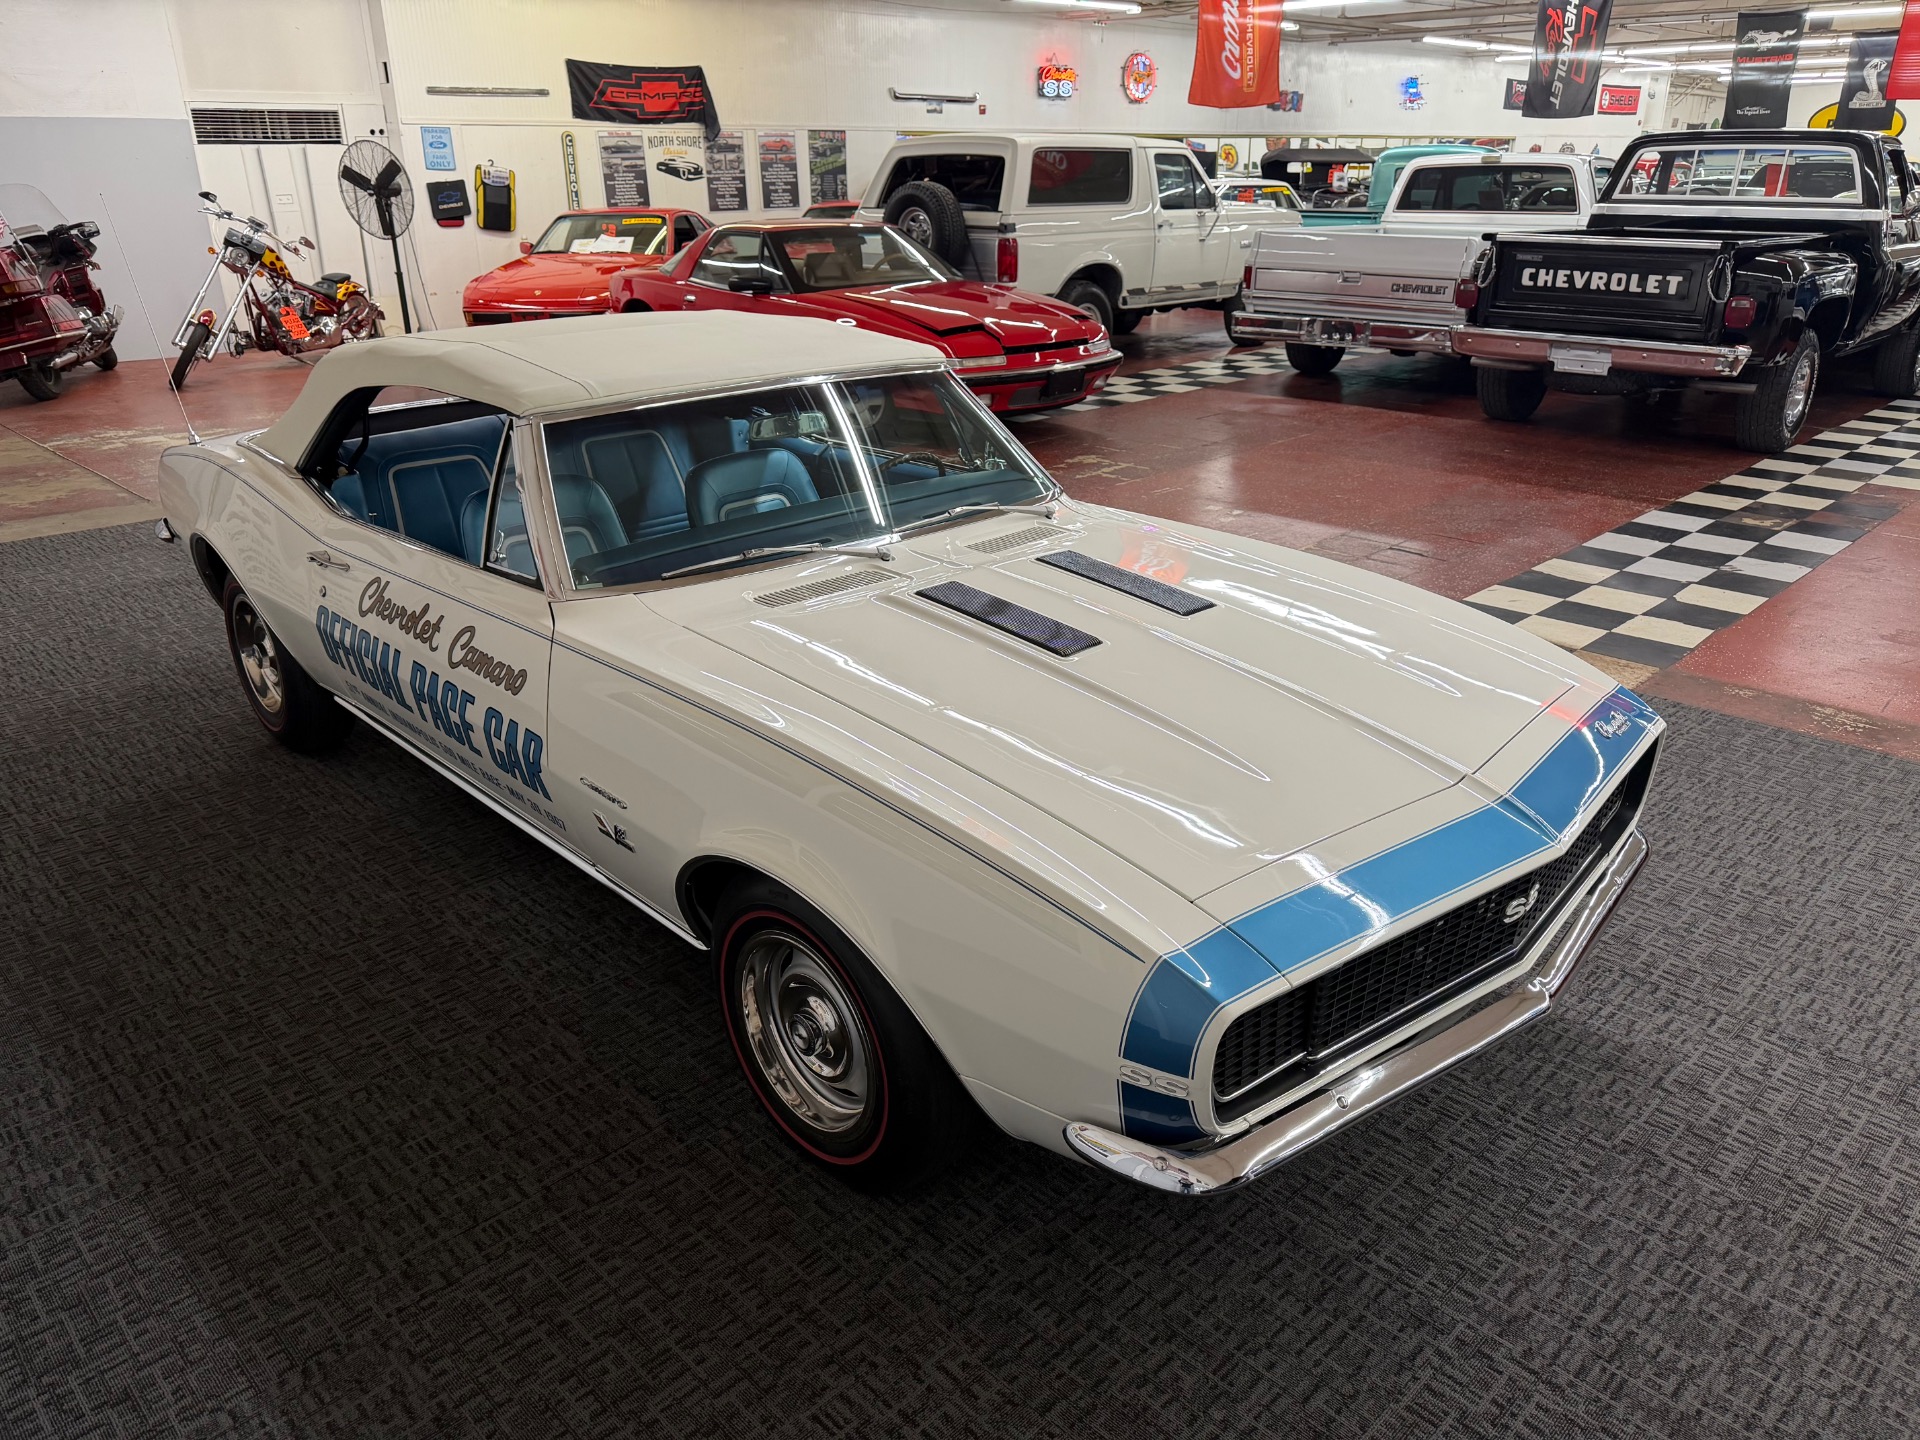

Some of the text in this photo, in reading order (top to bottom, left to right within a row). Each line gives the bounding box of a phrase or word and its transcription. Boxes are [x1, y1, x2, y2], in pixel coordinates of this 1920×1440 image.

[1246, 15, 1254, 86] CHEVROLET
[1549, 0, 1580, 109] HEVROLET
[1736, 53, 1794, 64] MUSTANG
[1043, 80, 1072, 97] SS
[1609, 94, 1639, 106] SHELBY
[647, 135, 703, 149] NORTH SHORE
[429, 160, 451, 168] ONLY
[565, 135, 580, 210] CHEVROLE
[438, 201, 464, 209] CHEVROLET
[1390, 282, 1449, 296] CHEVROLET
[1521, 267, 1684, 296] CHEVROLET
[358, 576, 528, 696] Chevrolet Camaro
[316, 604, 554, 803] OFFICIAL PACE CAR
[1120, 1064, 1189, 1097] SS
